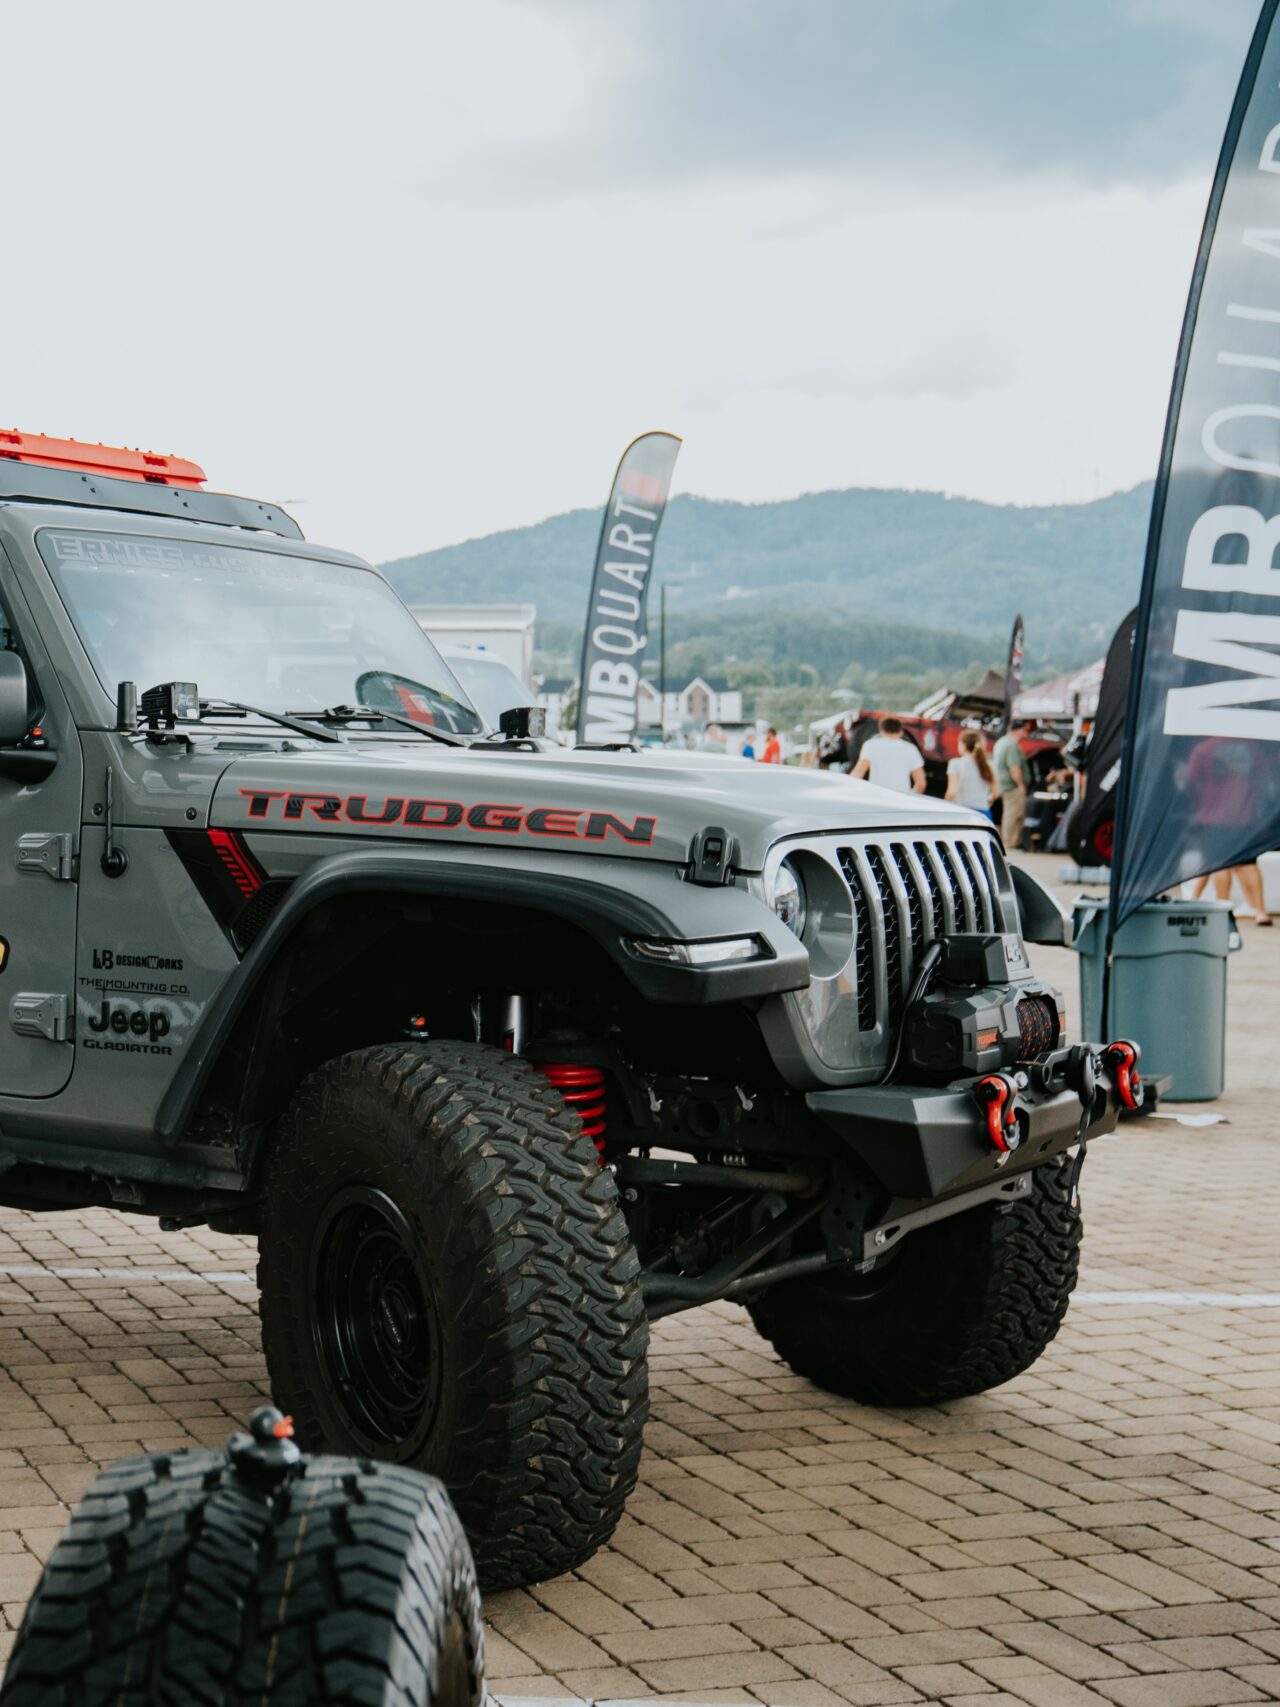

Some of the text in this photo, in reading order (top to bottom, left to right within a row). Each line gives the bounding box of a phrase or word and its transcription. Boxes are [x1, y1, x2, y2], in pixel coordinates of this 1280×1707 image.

[51, 535, 185, 569] ERNIES
[584, 497, 656, 743] MBQUART
[238, 788, 658, 846] TRUDGEN
[79, 977, 190, 995] THE MOUNTING CO.
[88, 1001, 170, 1042] Jeep
[83, 1040, 173, 1056] GLADIATOR
